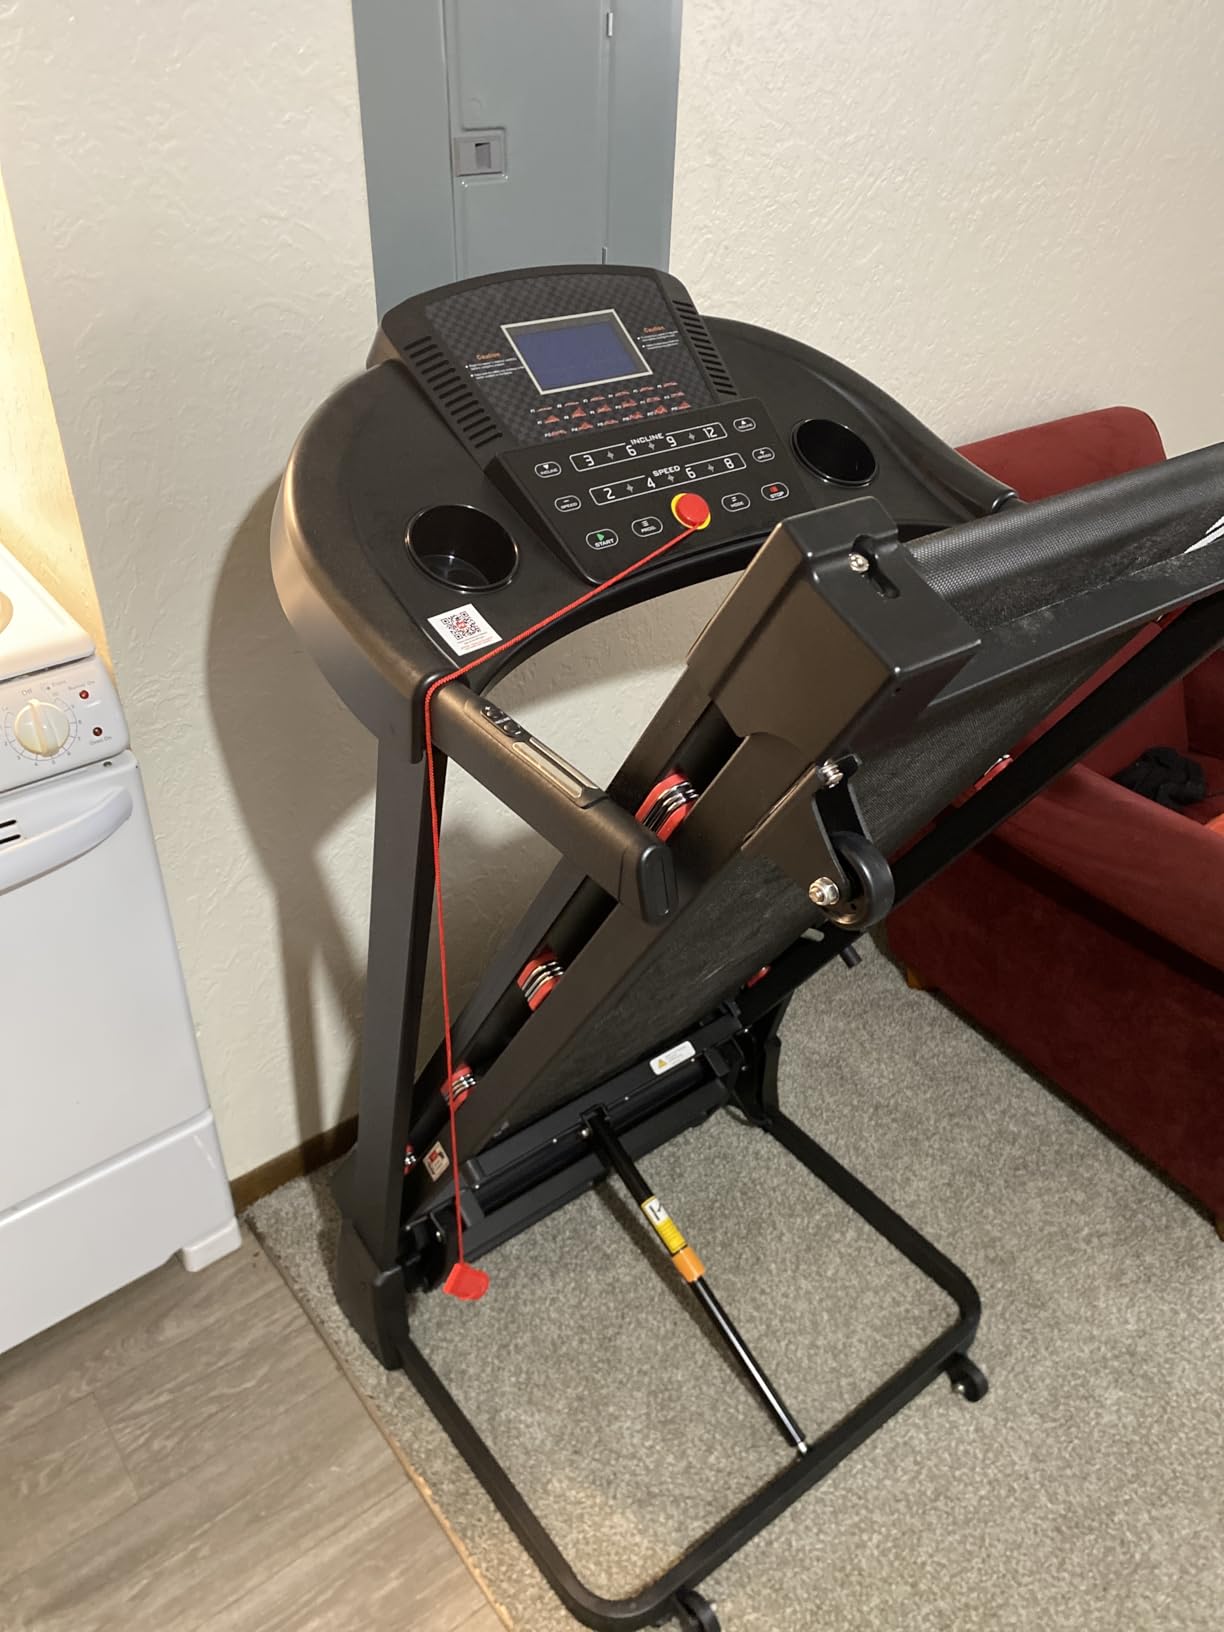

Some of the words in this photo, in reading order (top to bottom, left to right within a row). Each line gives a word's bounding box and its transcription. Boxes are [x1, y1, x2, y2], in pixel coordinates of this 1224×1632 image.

[631, 433, 665, 445] INCLINE
[583, 455, 595, 466] 3
[625, 444, 637, 457] 6
[666, 435, 677, 448] 9
[702, 426, 718, 439] 12
[652, 465, 680, 476] SPEED
[603, 488, 615, 499] 2
[647, 477, 656, 489] 4
[685, 467, 696, 479] 6
[723, 457, 735, 470] 8
[594, 537, 615, 548] START
